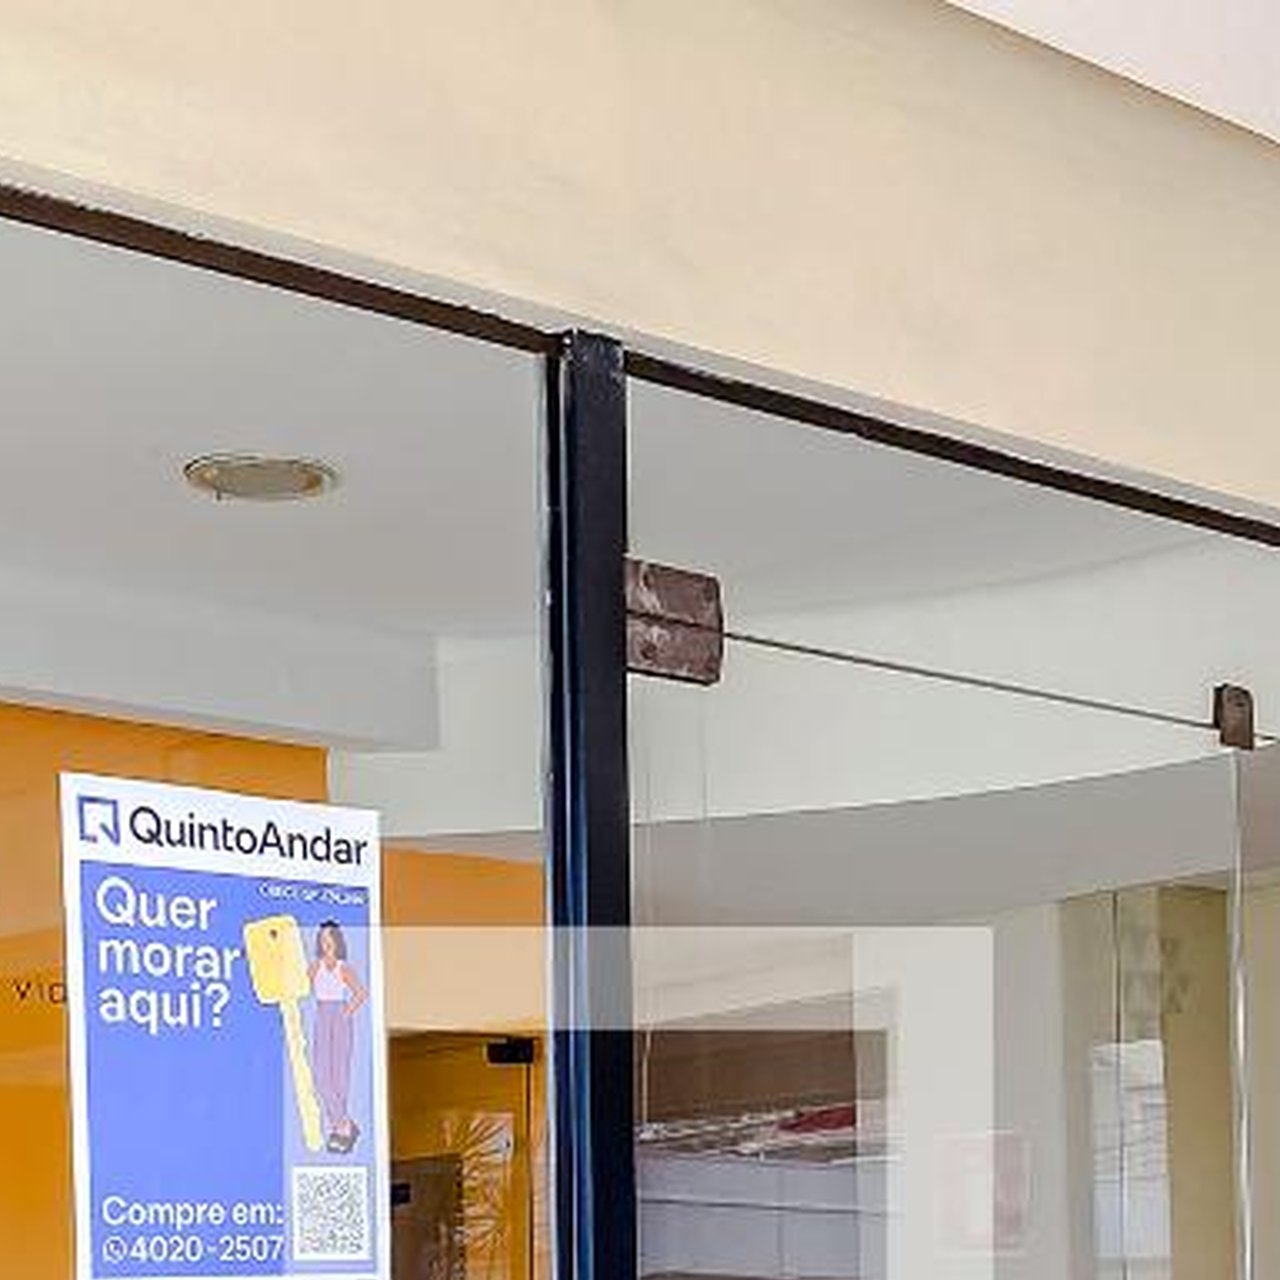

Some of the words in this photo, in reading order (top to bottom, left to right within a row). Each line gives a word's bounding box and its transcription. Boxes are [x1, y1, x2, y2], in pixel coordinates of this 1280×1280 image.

[129, 805, 368, 866] QuintoAndar
[96, 876, 217, 931] Quer
[98, 938, 240, 981] morar
[98, 982, 231, 1035] aqui?
[102, 1195, 225, 1231] Compre
[231, 1202, 285, 1225] em:
